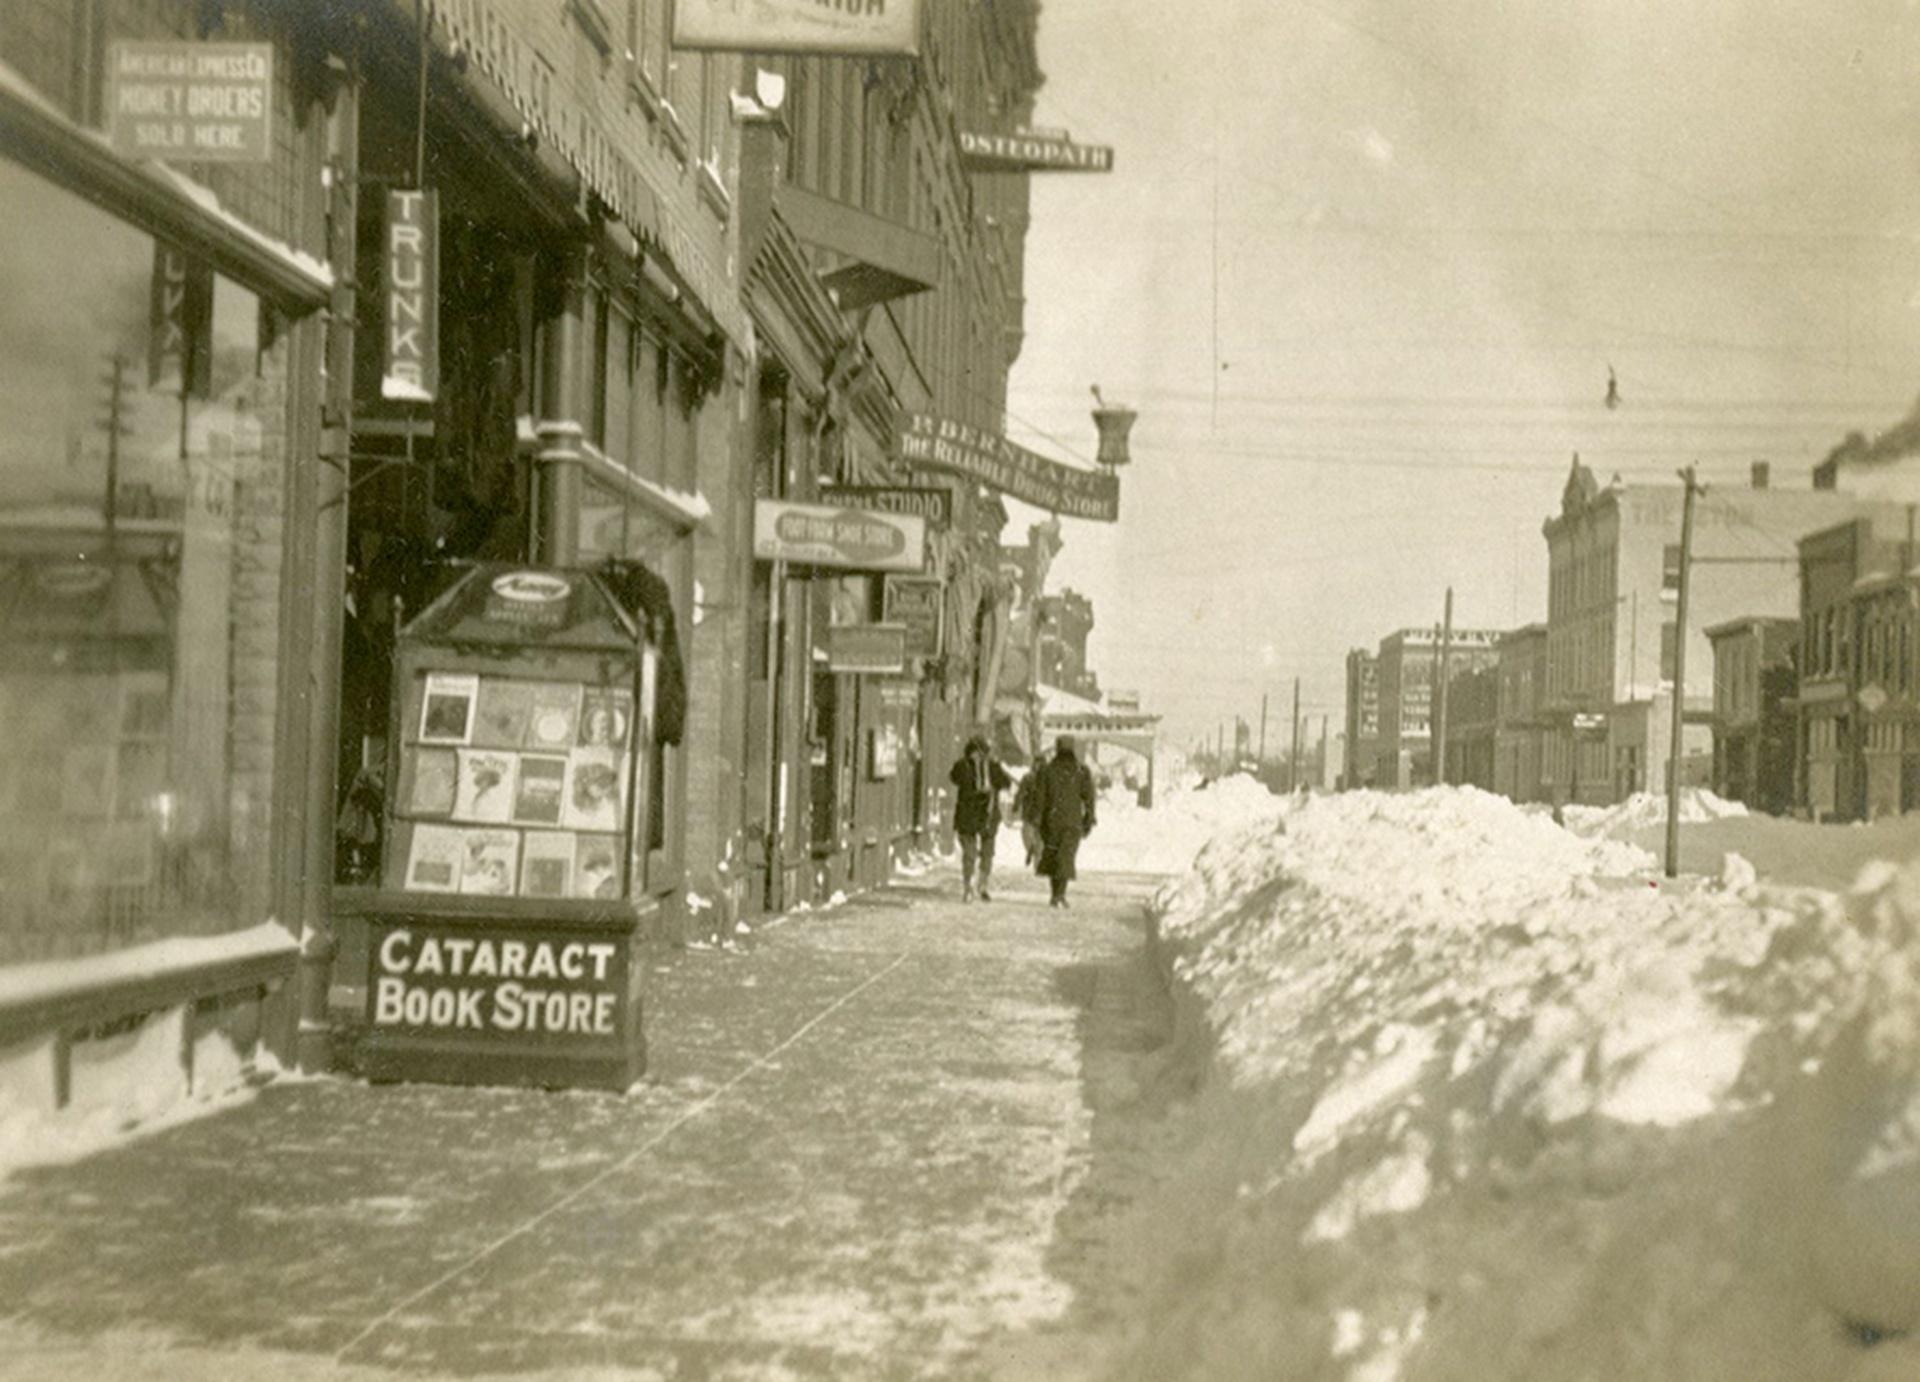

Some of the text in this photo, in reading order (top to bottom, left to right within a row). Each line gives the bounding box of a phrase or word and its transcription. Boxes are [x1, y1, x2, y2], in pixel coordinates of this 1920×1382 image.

[119, 85, 263, 118] MONEY ORDERS
[135, 123, 245, 149] SOLD HERE
[960, 132, 1107, 168] OSTEOPATH
[876, 492, 943, 522] STUDIO
[380, 930, 617, 980] CATARACT
[375, 976, 617, 1034] BOOK STORE
